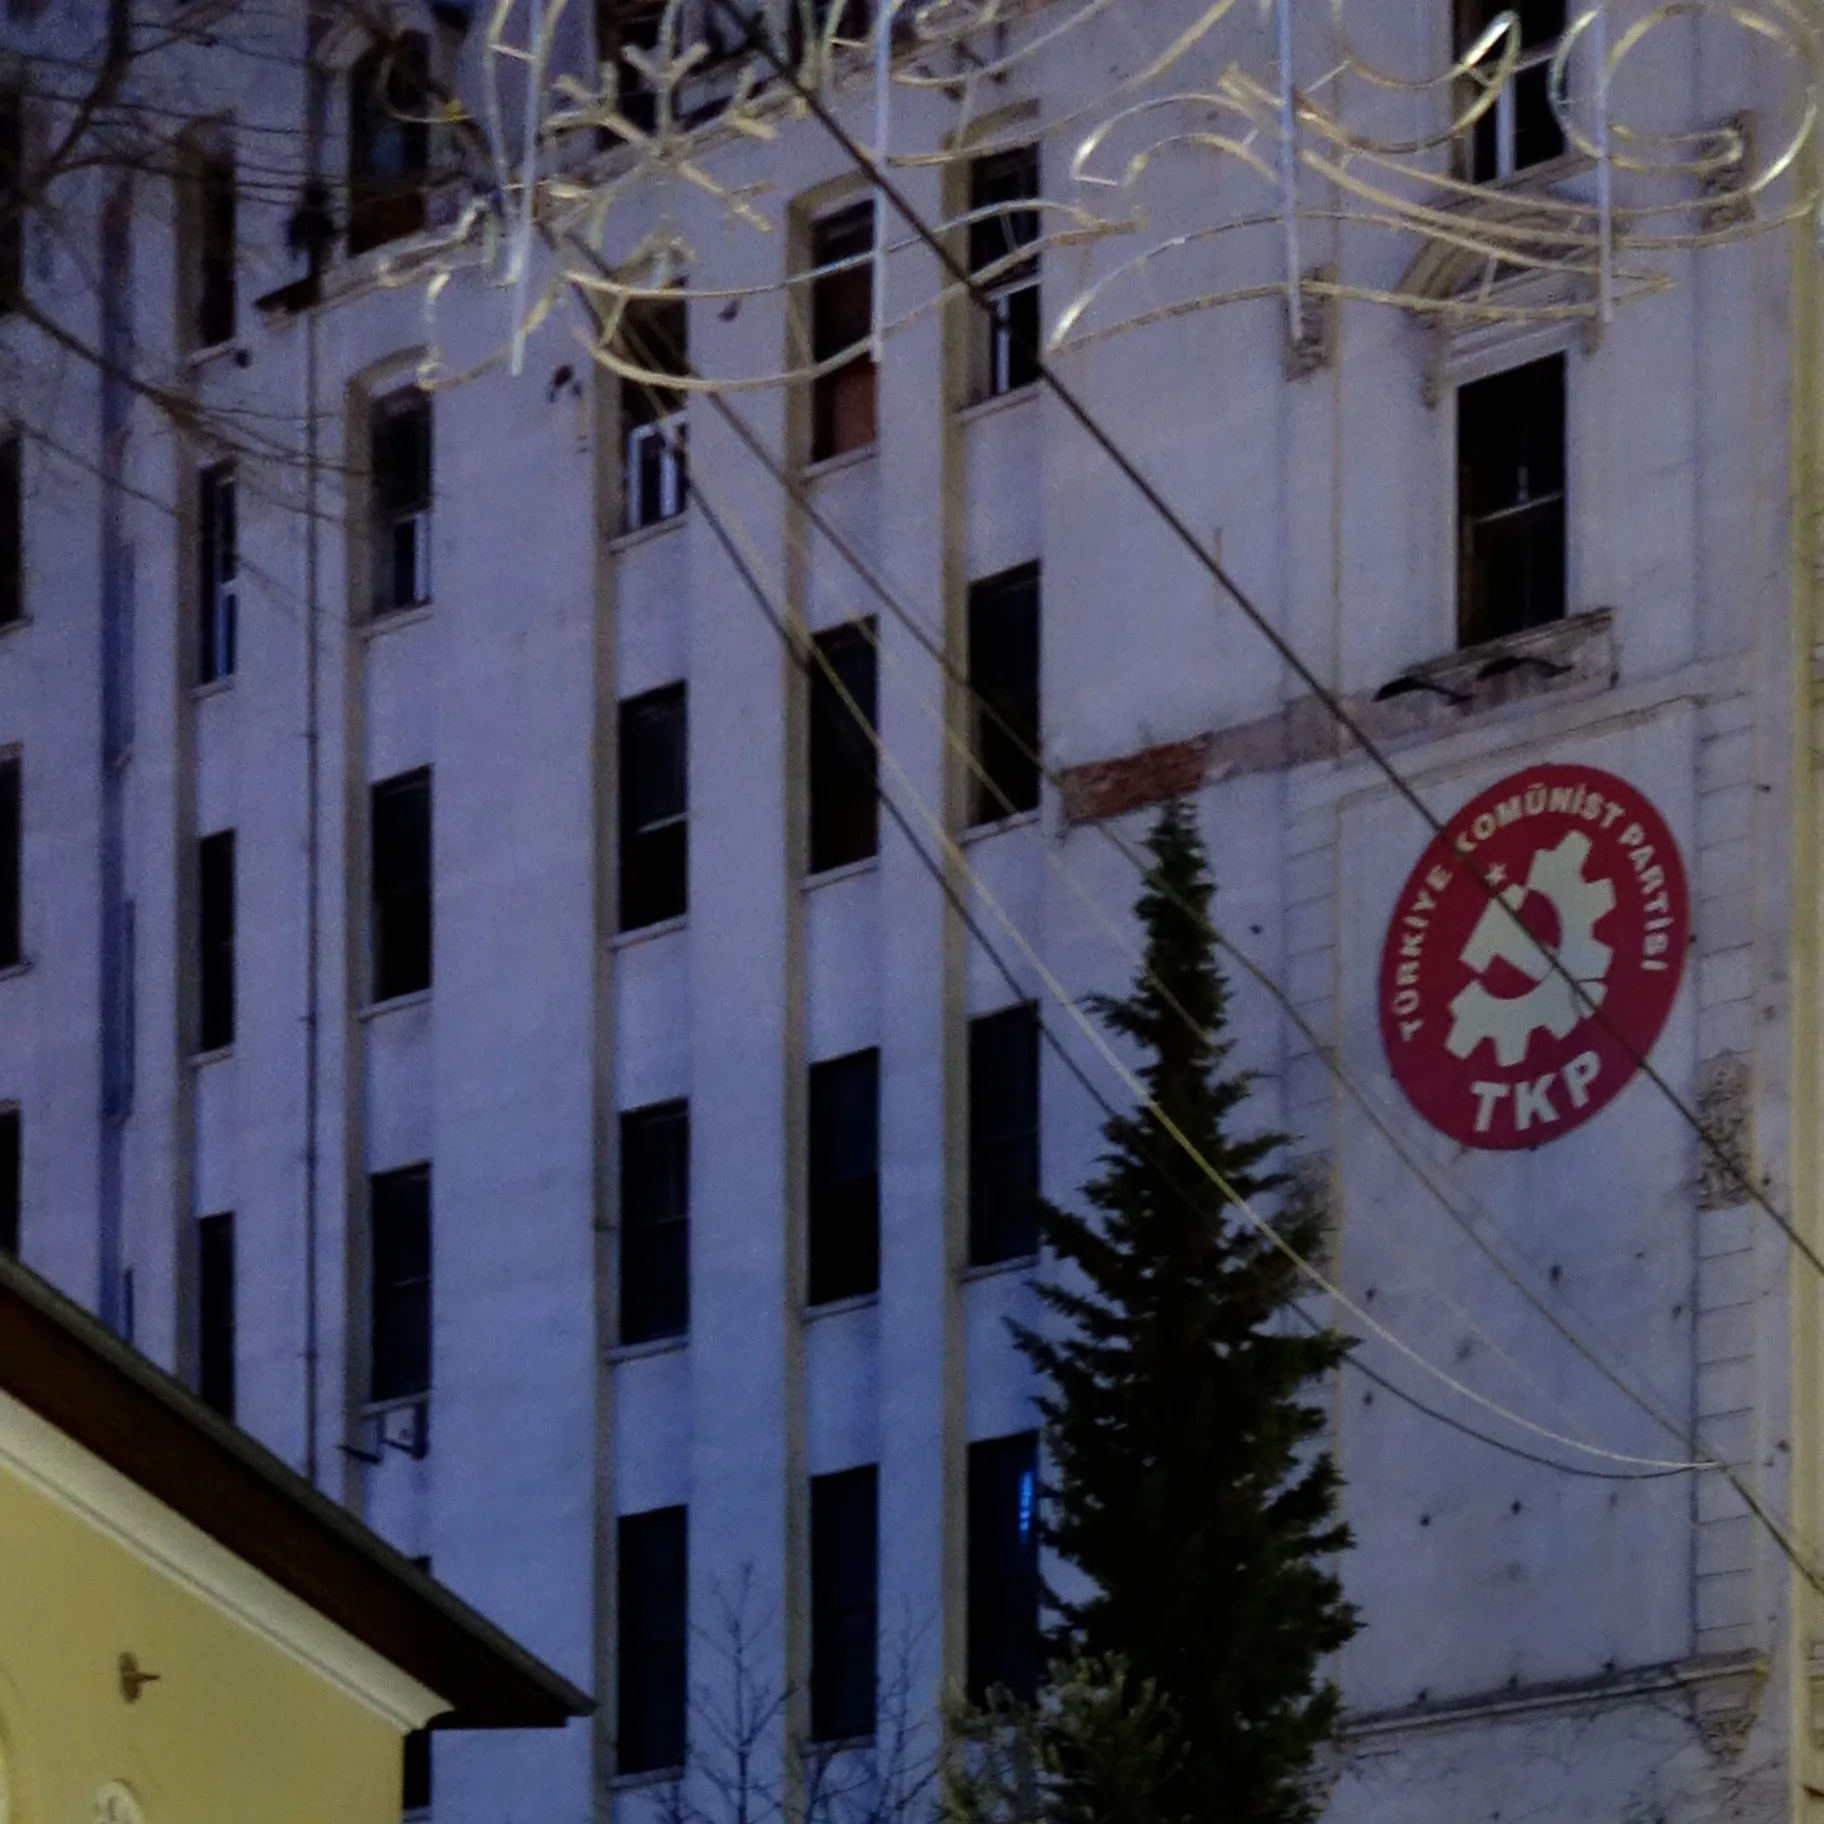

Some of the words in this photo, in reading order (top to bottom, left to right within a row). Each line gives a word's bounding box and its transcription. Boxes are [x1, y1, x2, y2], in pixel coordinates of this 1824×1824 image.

[1391, 865, 1453, 1041] TÜRKİYE
[1455, 782, 1625, 852] KOMÜNİST
[1470, 1050, 1601, 1133] TKP
